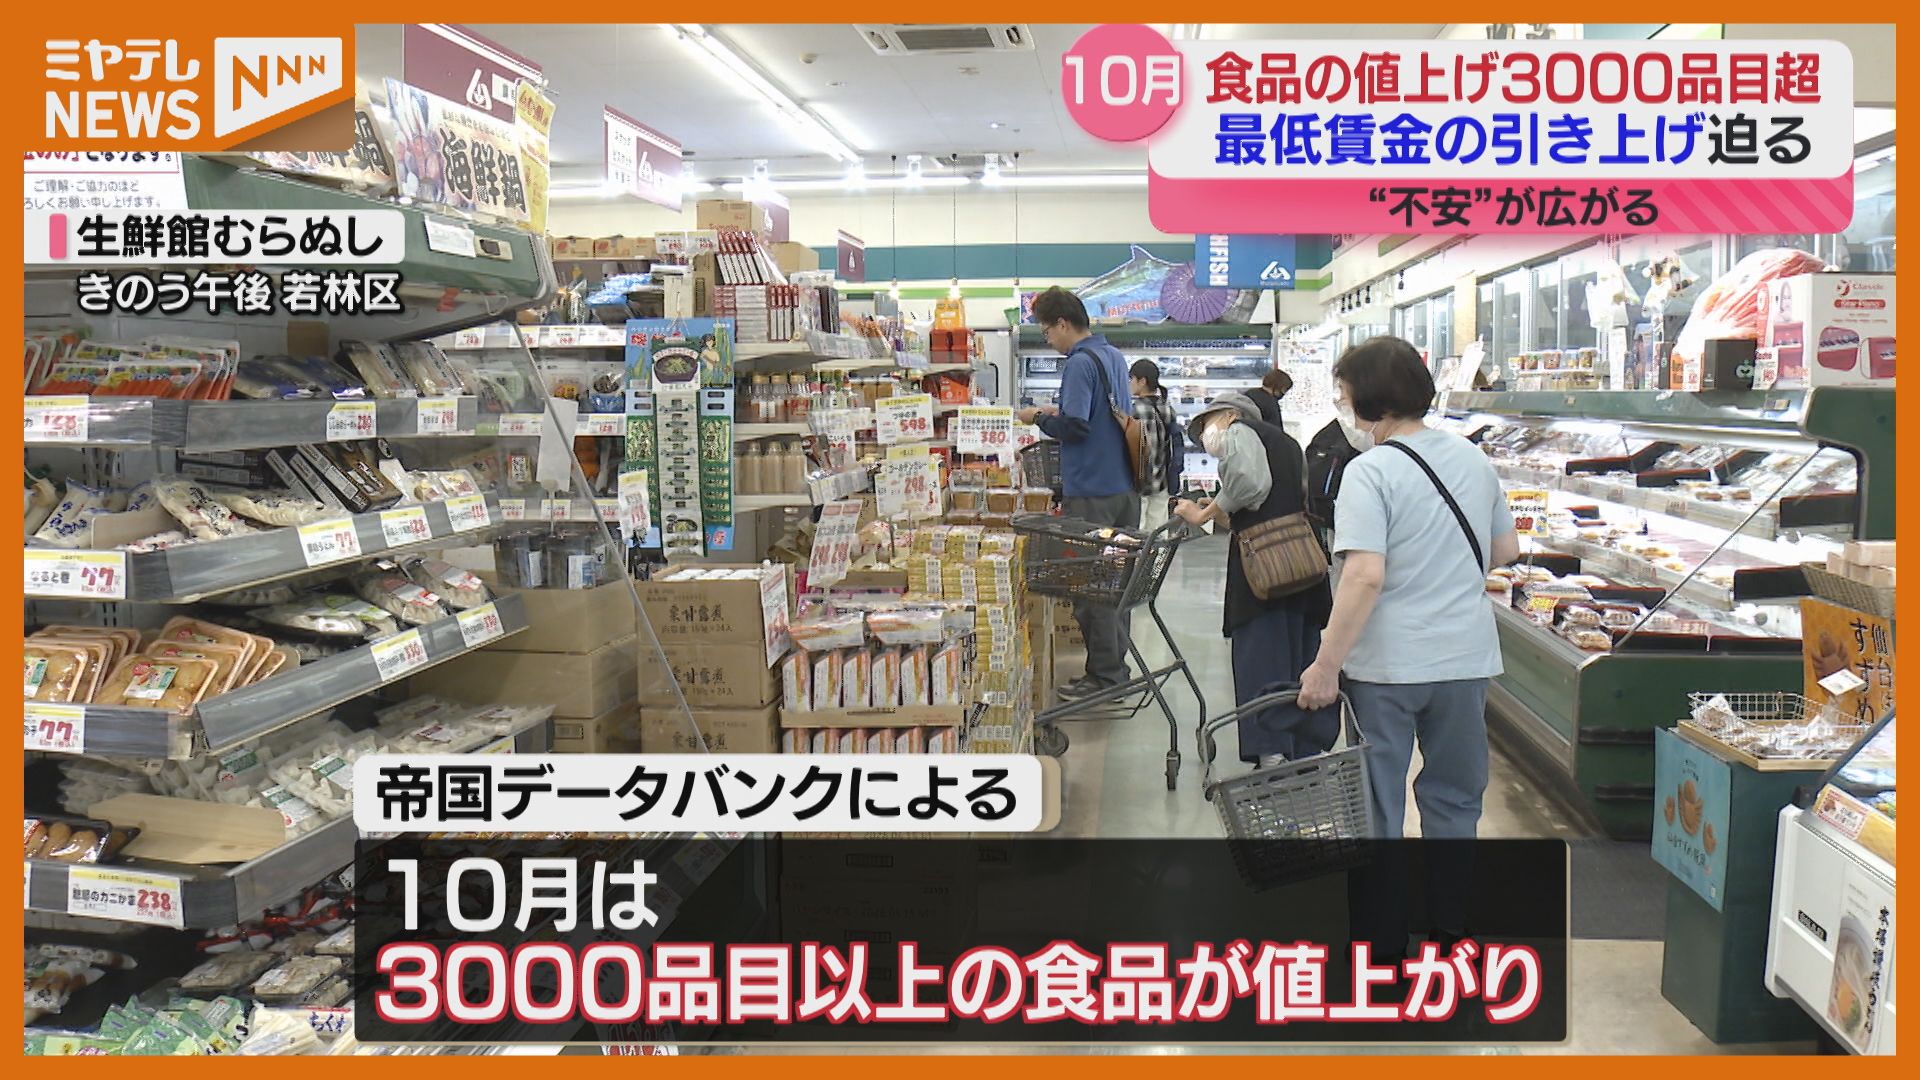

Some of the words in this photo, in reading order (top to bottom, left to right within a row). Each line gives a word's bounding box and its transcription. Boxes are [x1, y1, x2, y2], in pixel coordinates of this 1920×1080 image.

[438, 127, 527, 214] 海鮮鍋
[899, 417, 927, 432] 598
[980, 430, 1006, 445] 380
[81, 566, 116, 586] 77
[39, 719, 73, 741] 77
[137, 888, 172, 912] 238
